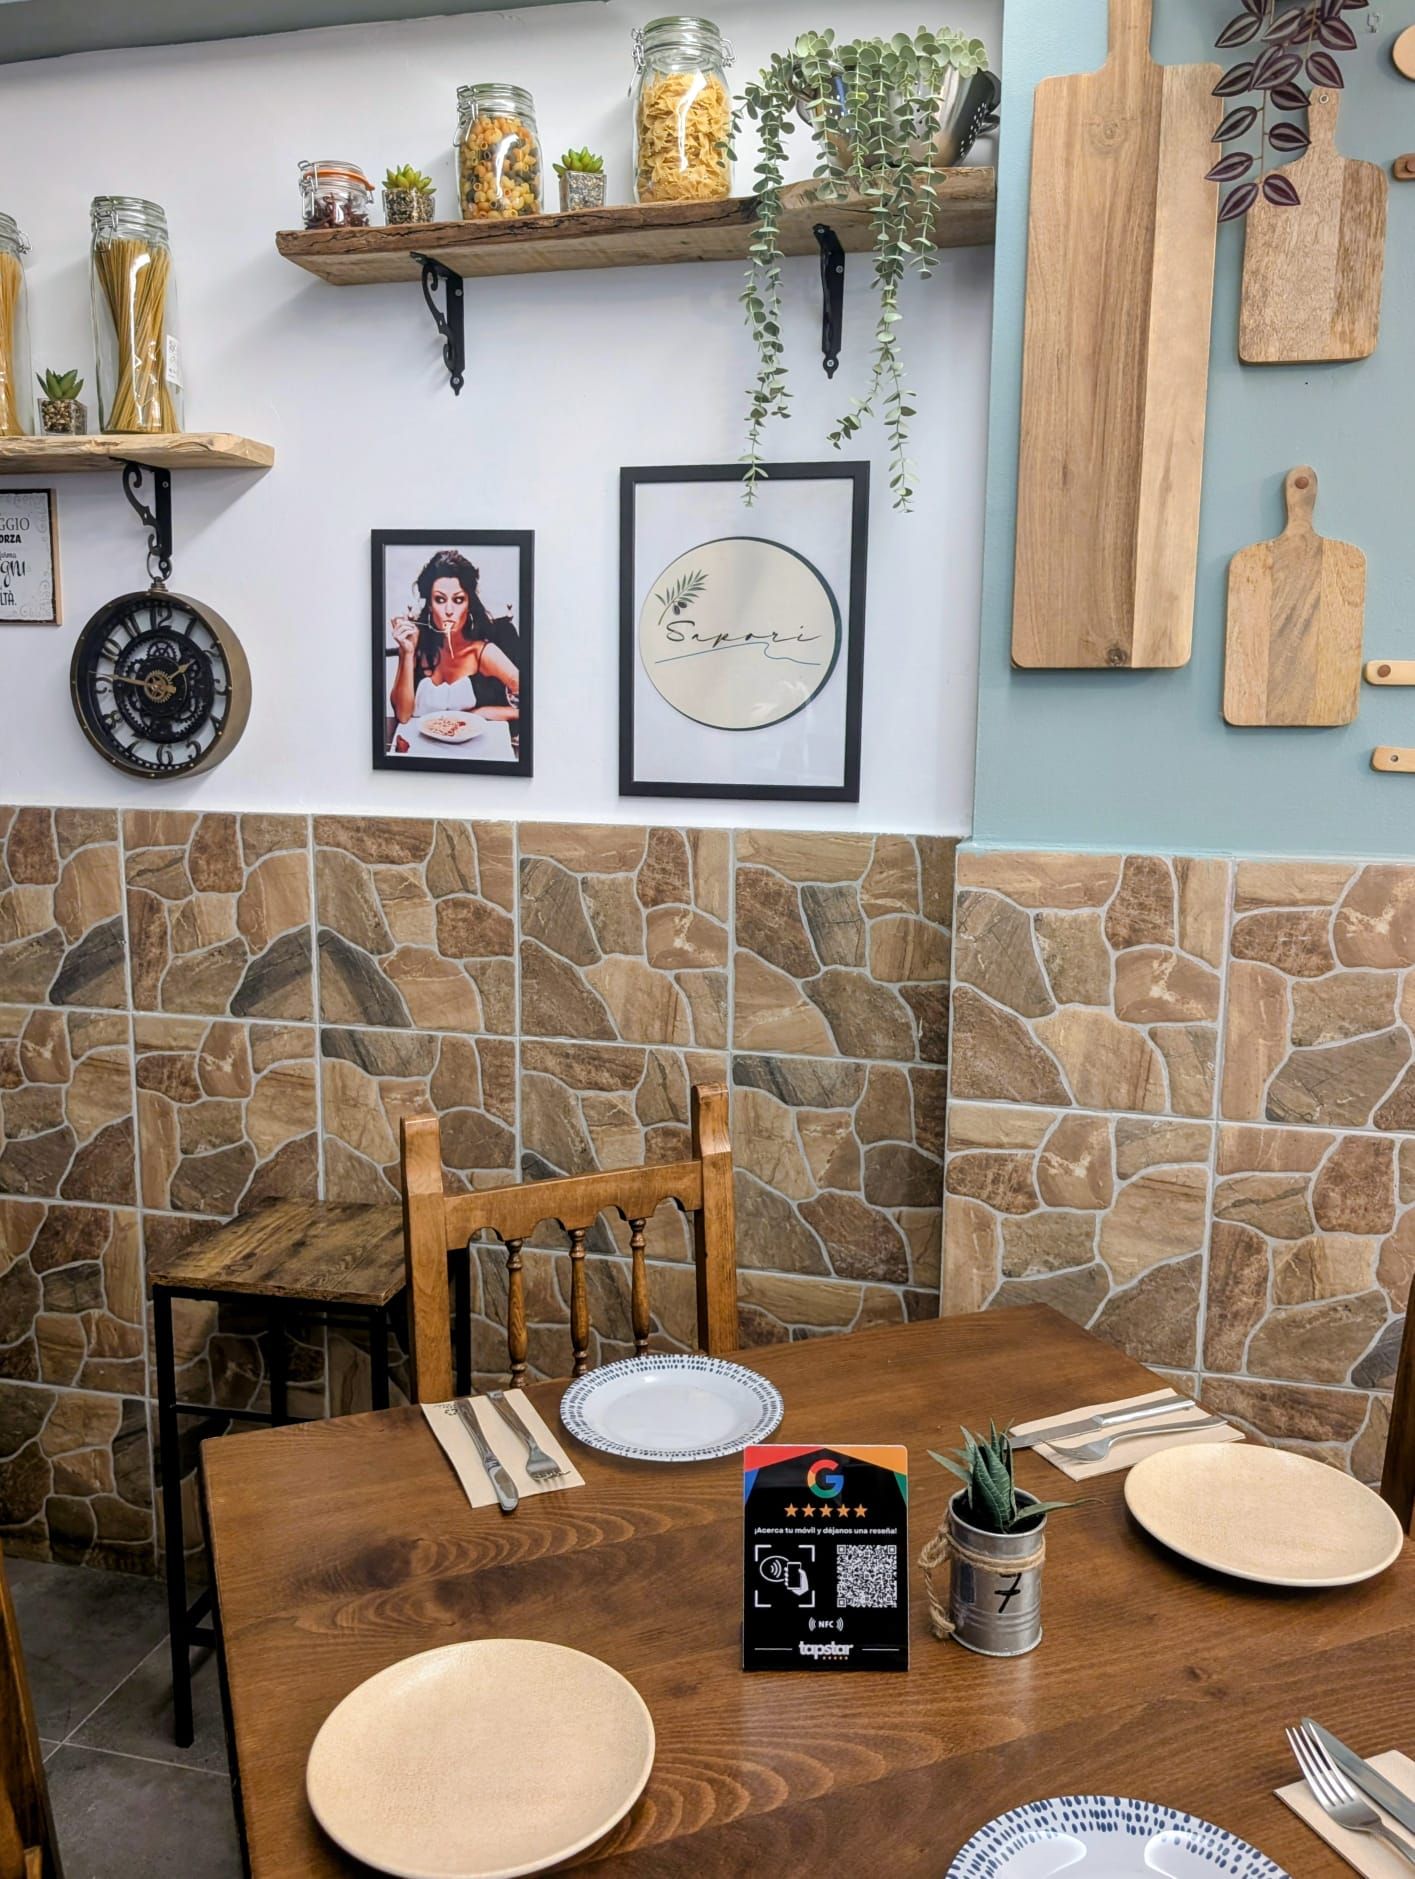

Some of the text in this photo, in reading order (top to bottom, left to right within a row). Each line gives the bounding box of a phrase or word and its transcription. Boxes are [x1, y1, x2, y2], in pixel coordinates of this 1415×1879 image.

[666, 620, 822, 648] Sapori
[754, 1527, 784, 1536] ¡Acerca
[795, 1526, 816, 1535] móvil
[817, 1528, 822, 1536] y
[823, 1526, 853, 1536] déjanos
[870, 1527, 898, 1535] reseña!
[993, 1571, 1022, 1614] 7
[818, 1620, 834, 1629] NFC
[798, 1640, 854, 1660] tapstar
